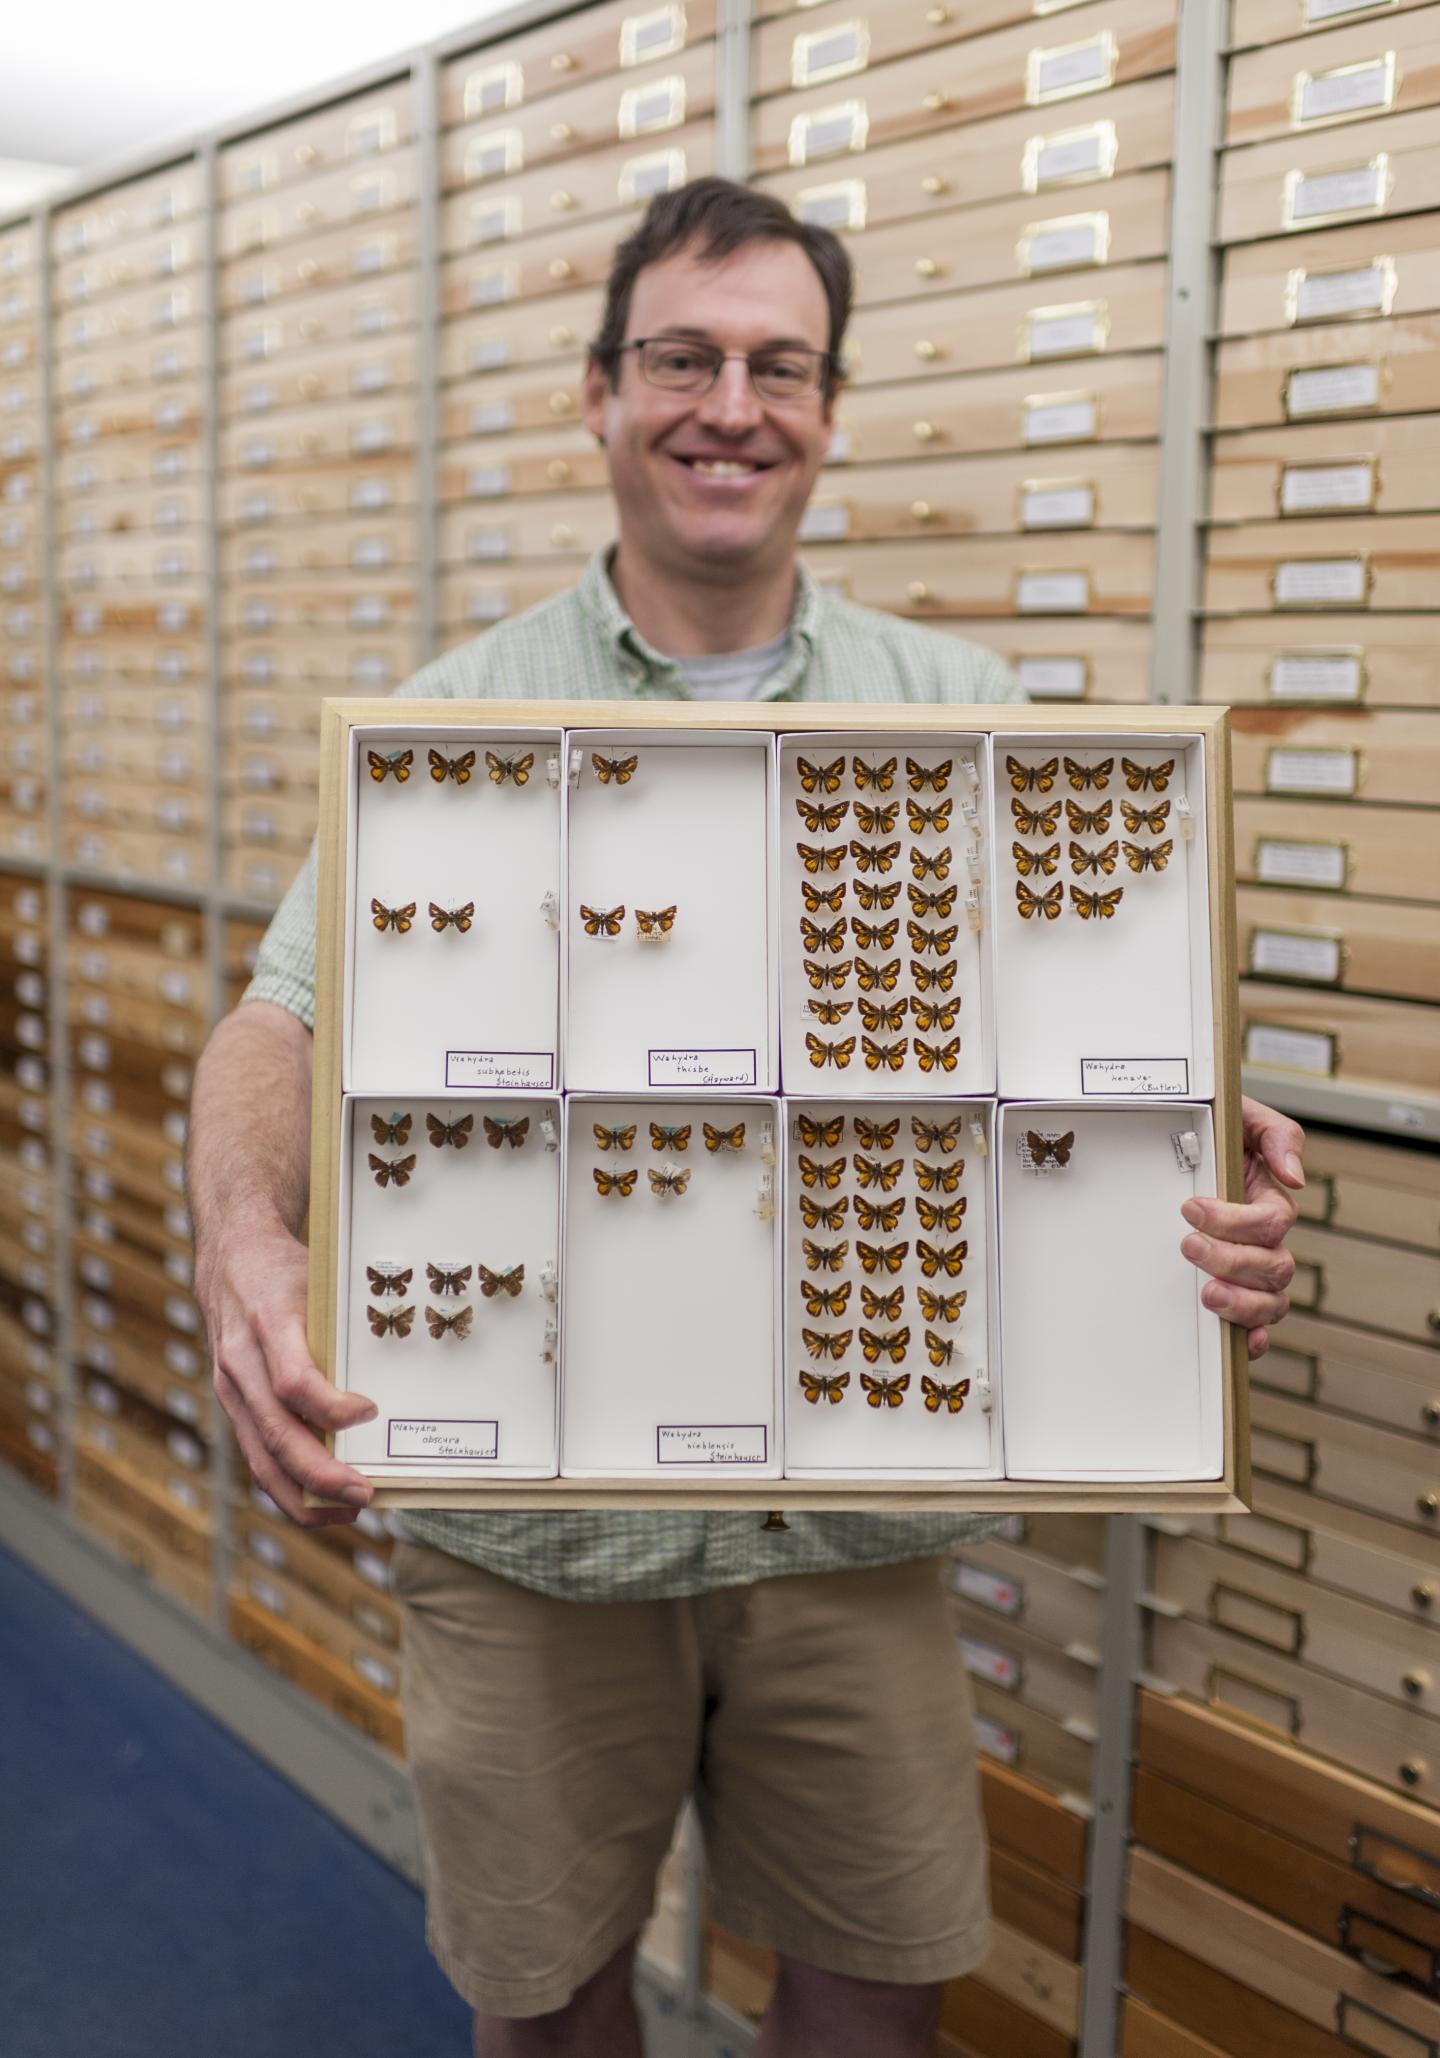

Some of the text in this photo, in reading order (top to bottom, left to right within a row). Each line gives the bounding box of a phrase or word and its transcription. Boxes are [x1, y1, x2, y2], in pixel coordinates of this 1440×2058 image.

[652, 1054, 699, 1064] Wahydra
[677, 1065, 709, 1073] thisbe
[1085, 1063, 1126, 1072] Wahydra
[702, 1073, 750, 1084] (Hayward)
[1141, 1083, 1183, 1093] (Butler)
[393, 1423, 437, 1434] Wahydra
[661, 1431, 702, 1440] Wahydra
[438, 1446, 497, 1456] Steinhauser
